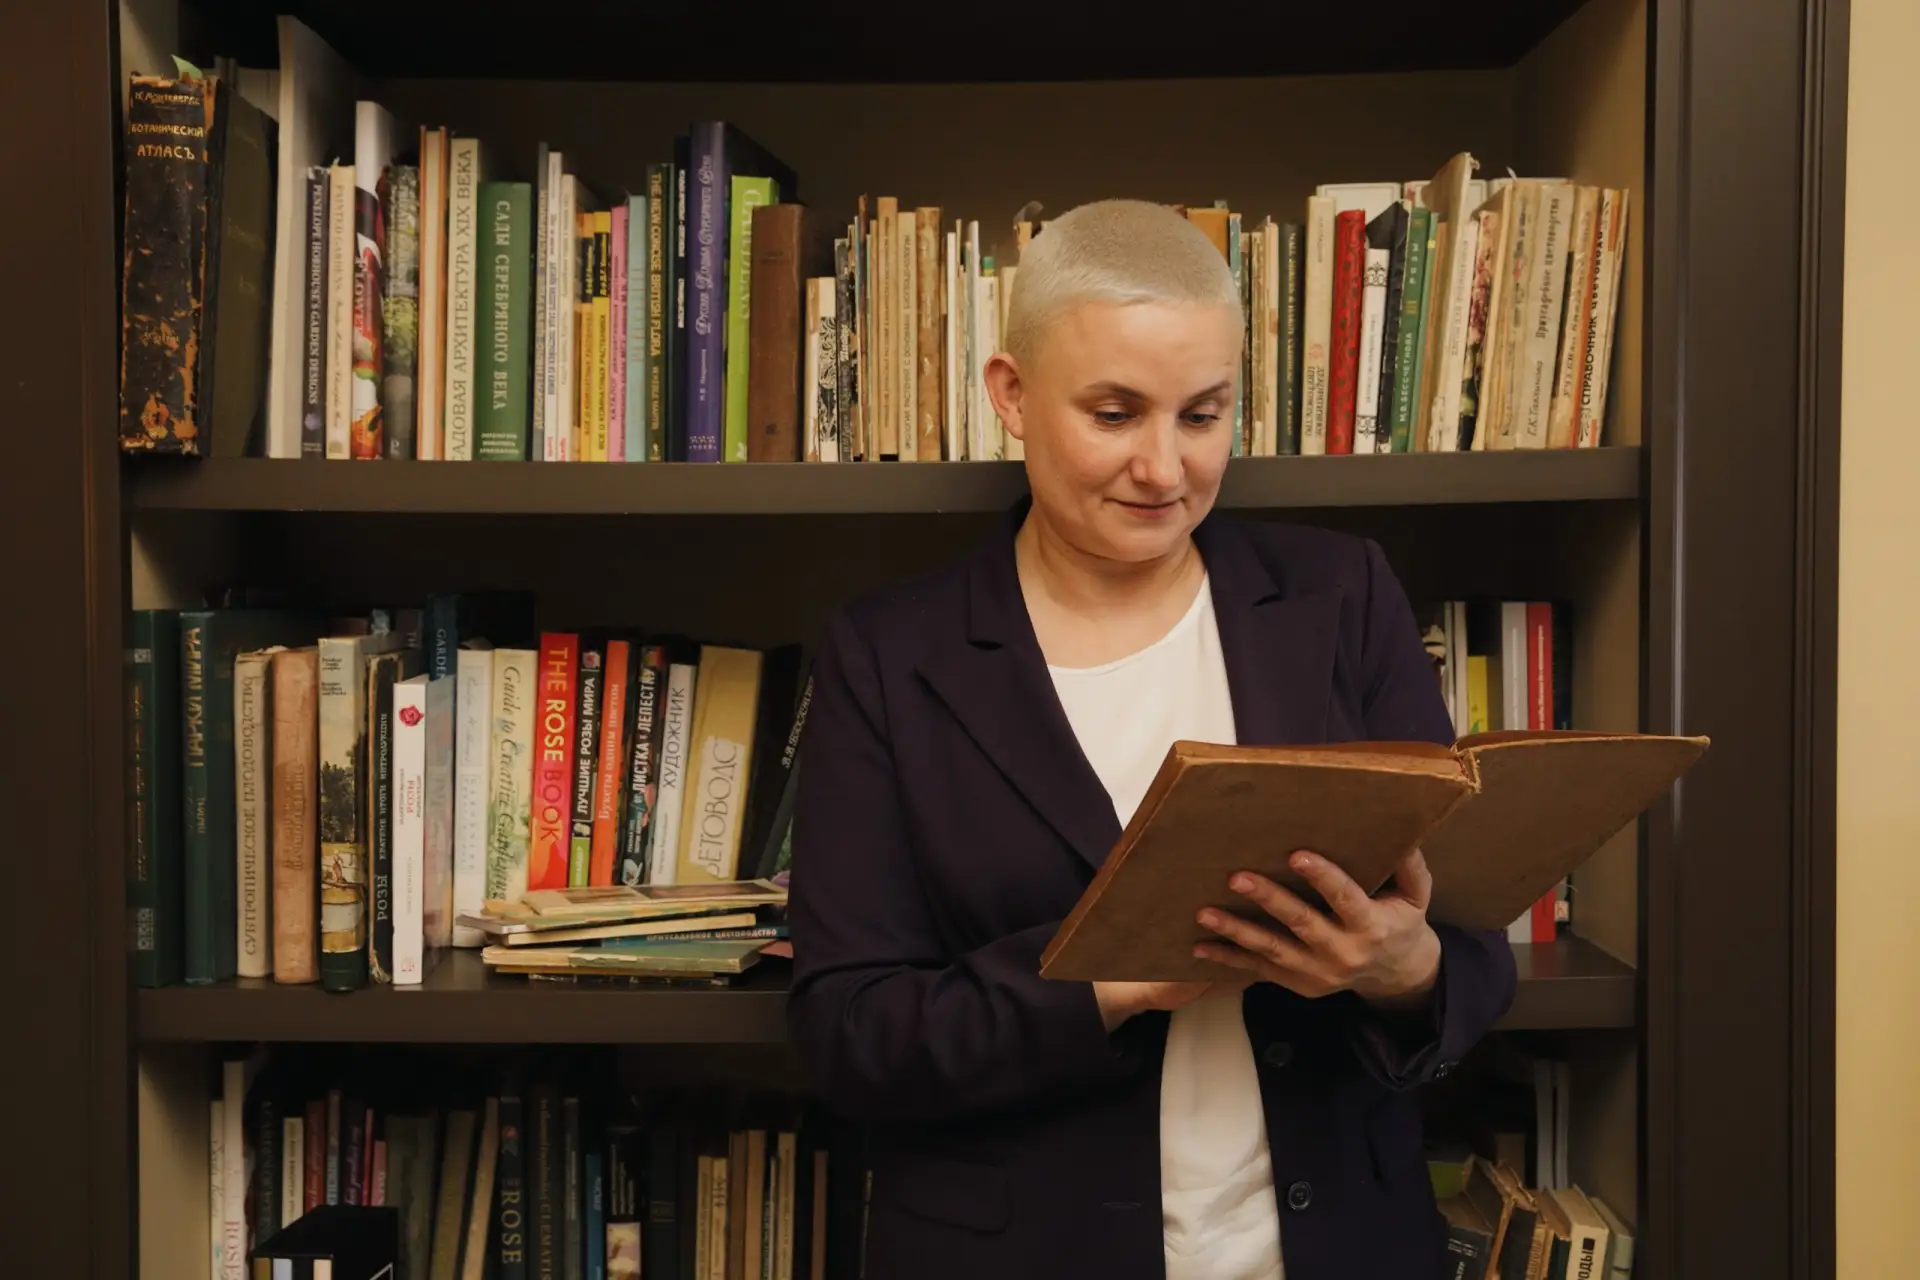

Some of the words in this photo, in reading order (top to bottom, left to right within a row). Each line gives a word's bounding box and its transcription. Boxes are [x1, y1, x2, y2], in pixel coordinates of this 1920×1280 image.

[137, 144, 195, 160] АТЛАСЪ
[458, 149, 472, 199] ВЕКА
[650, 173, 662, 196] THE
[312, 185, 323, 240] PENELOPE
[457, 204, 471, 237] XIX
[494, 201, 511, 246] САДЫ
[650, 198, 662, 224] NEW
[1543, 198, 1560, 265] цветоводство
[650, 226, 662, 271] CONCISE
[455, 242, 471, 373] АРХИТЕКТУРА
[493, 254, 510, 362] СЕРЕБРЯНОГО
[650, 274, 662, 317] BRITISH
[1535, 269, 1552, 339] Приусадебное
[309, 311, 321, 357] GARDEN
[649, 319, 661, 356] FLORA
[308, 358, 320, 405] DESIGNS
[1581, 316, 1597, 406] СПРАВОЧНИК
[492, 370, 509, 410] ВЕКА
[903, 368, 911, 408] РАСТЕНИЙ
[452, 380, 468, 461] САДОВАЯ
[185, 627, 203, 690] МИРА
[546, 647, 568, 691] THE
[502, 666, 521, 715] Guide
[582, 677, 596, 716] МИРА
[606, 683, 619, 728] цветом
[637, 668, 656, 733] ЛЕПЕСТКУ
[188, 696, 204, 767] ПАРКИ
[241, 678, 255, 802] ПЛОДОВОДСТВО
[379, 713, 388, 780] ИНТРОДУКЦИИ
[501, 719, 518, 734] to
[544, 699, 566, 761] ROSE
[580, 719, 593, 755] РОЗЫ
[661, 687, 685, 788] ХУДОЖНИК
[499, 739, 519, 807] Creative
[603, 731, 615, 771] одним
[632, 743, 649, 793] ЛИСТКА
[379, 784, 387, 814] ИТОГИ
[406, 780, 415, 814] РОЗЫ
[540, 769, 564, 841] BOOK
[577, 758, 591, 815] ЛУЧШИЕ
[598, 773, 613, 820] Букеты
[378, 818, 387, 860] КРАТКИЕ
[243, 808, 257, 955] СУБТРОПИЧЕСКОЕ
[376, 874, 388, 921] РОЗЫ
[715, 928, 777, 938] ЦВЕТОВОДСТВО
[225, 1220, 242, 1280] ROSE
[501, 1190, 521, 1265] ROSE
[1577, 1250, 1595, 1280] ОДЫ
